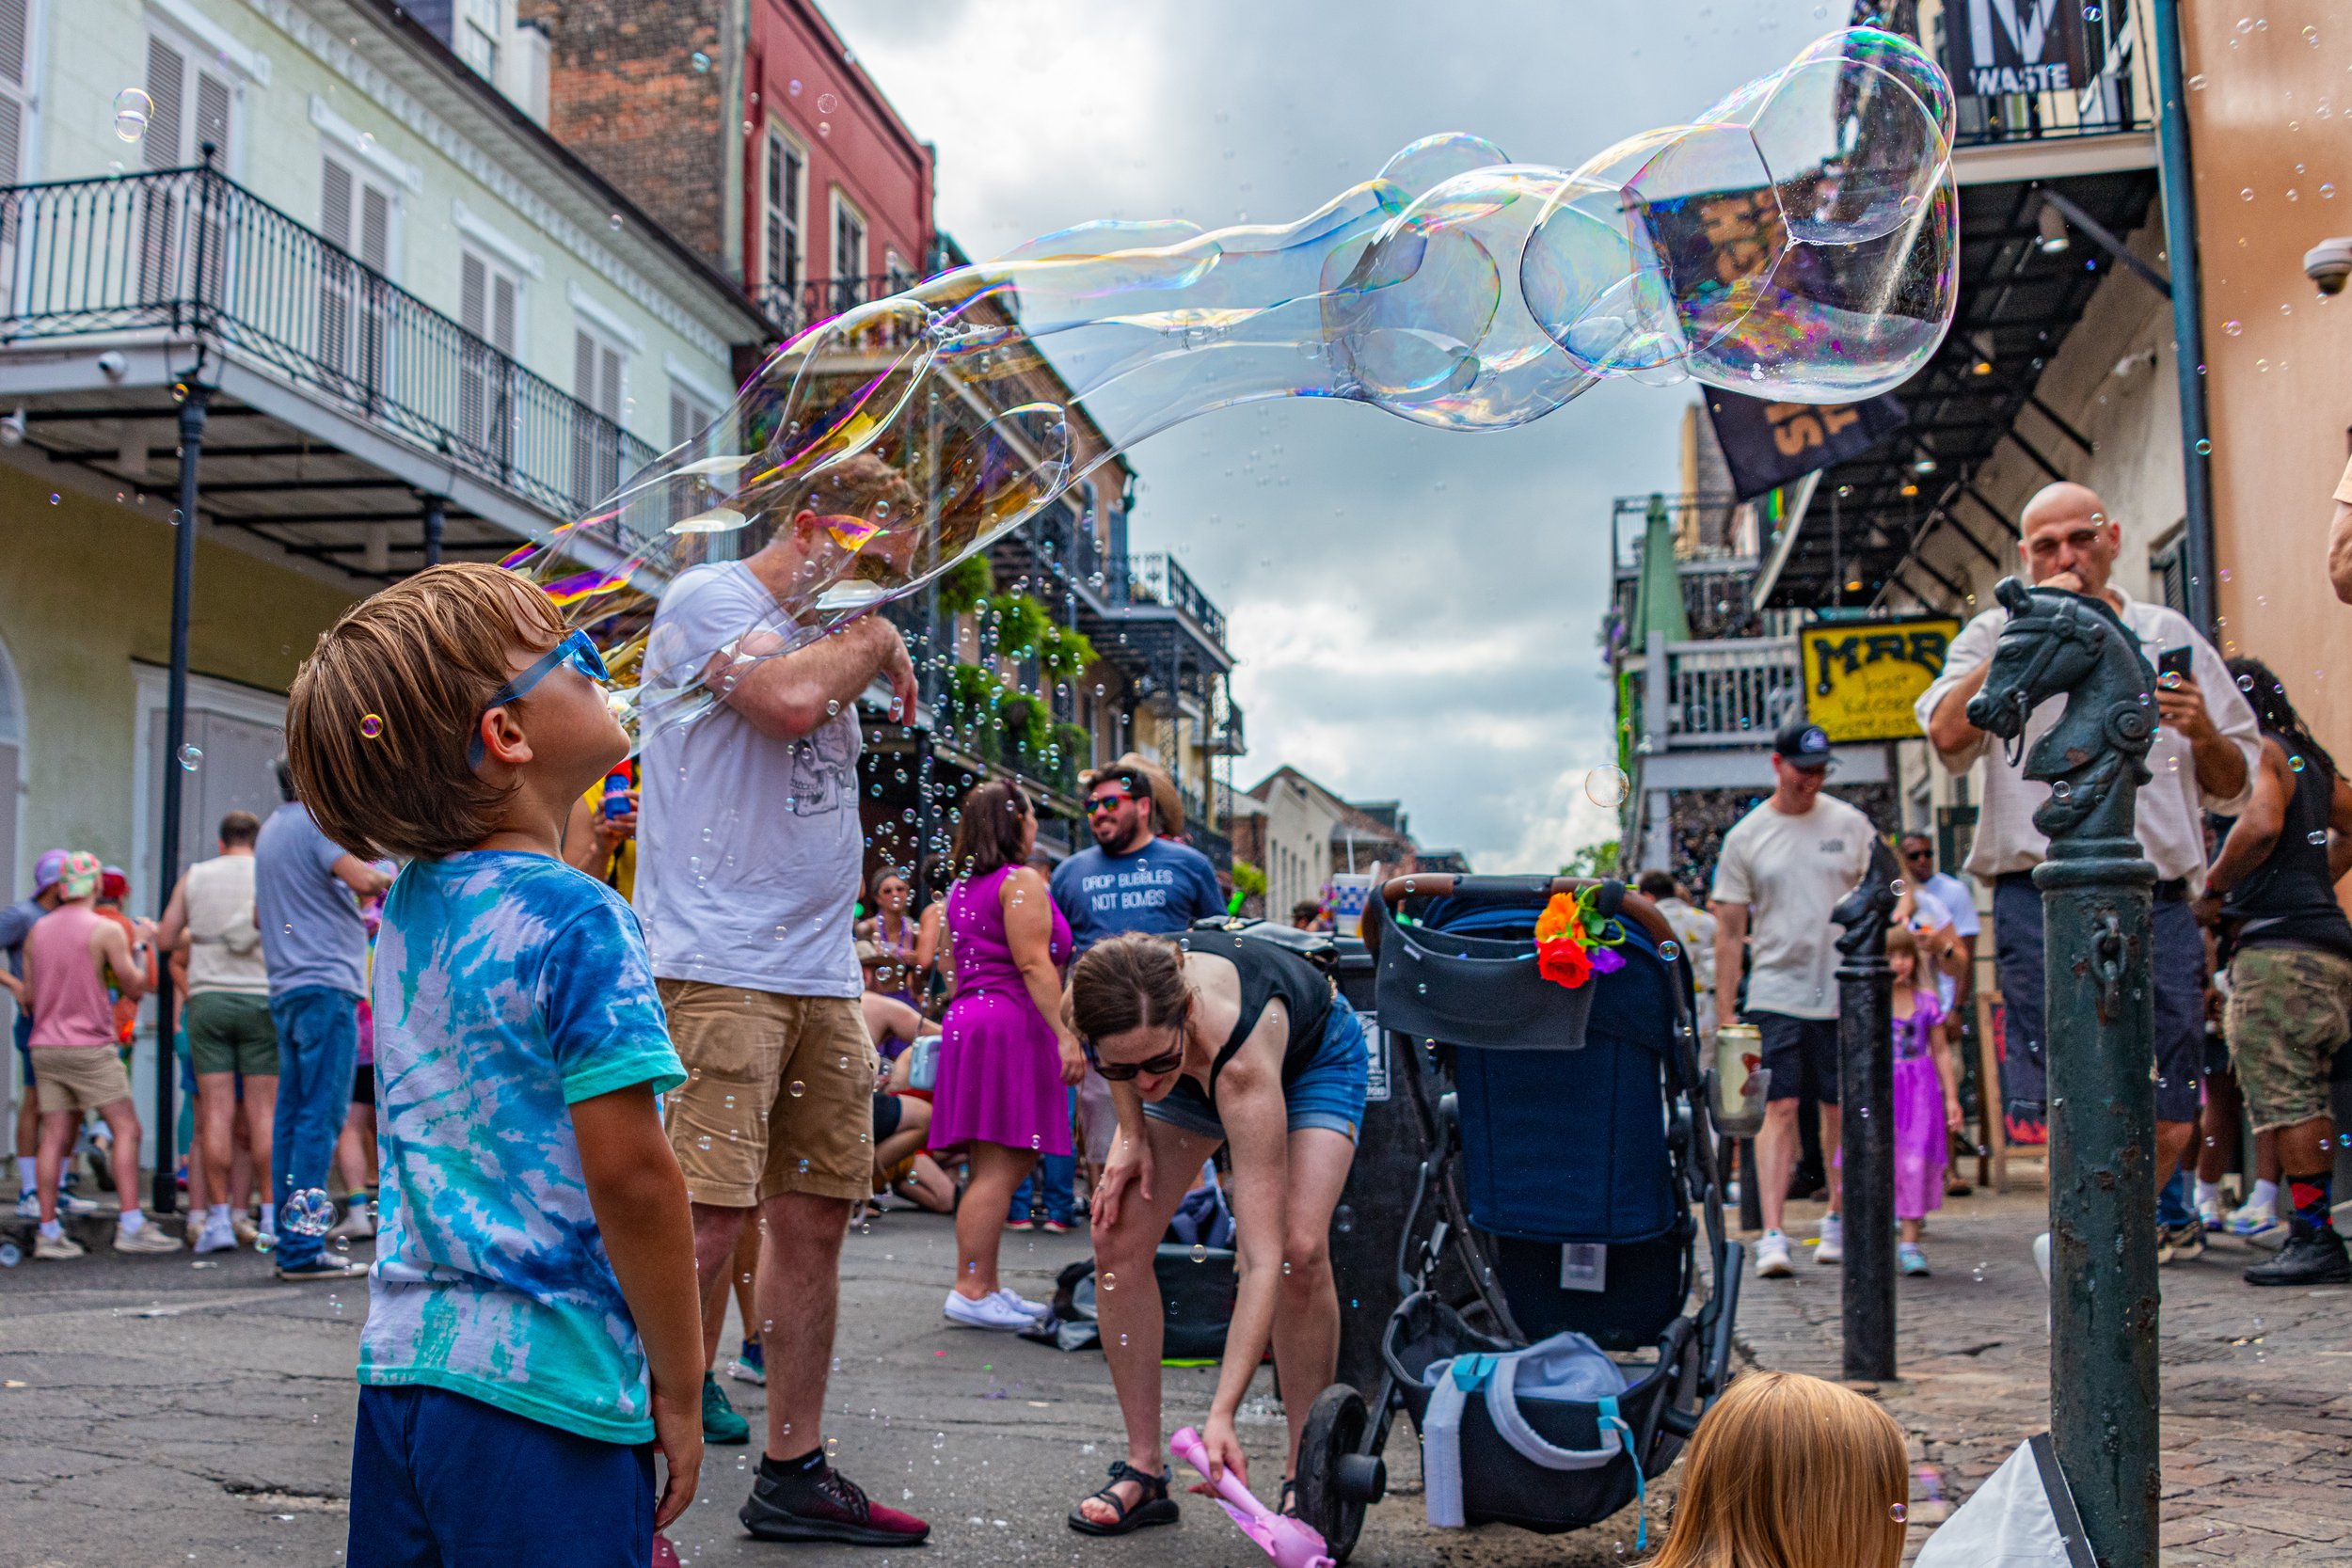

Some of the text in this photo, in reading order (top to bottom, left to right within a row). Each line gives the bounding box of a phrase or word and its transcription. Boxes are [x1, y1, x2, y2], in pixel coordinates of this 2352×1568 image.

[1969, 62, 2069, 95] WASTE
[1082, 869, 1173, 893] DROP BUBBLES
[1091, 889, 1167, 912] NOT BOMBS
